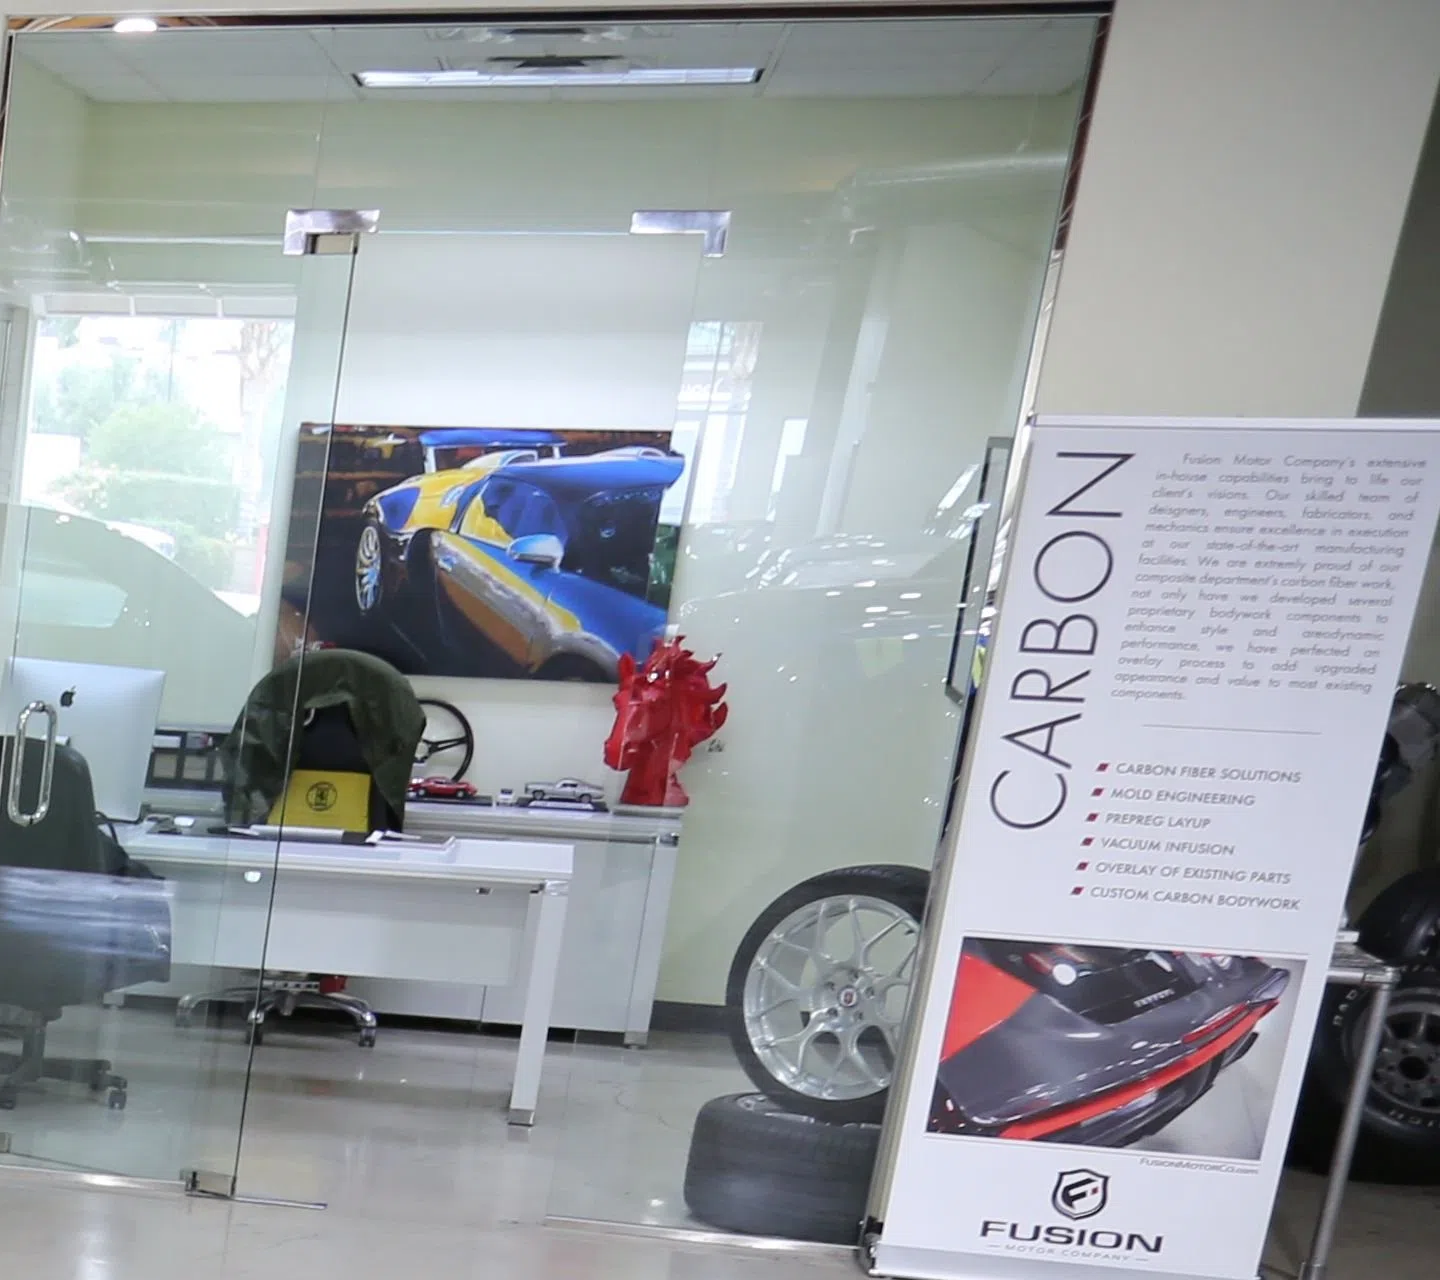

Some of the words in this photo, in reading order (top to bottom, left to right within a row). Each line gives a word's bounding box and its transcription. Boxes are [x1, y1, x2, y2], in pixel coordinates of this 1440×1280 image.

[1182, 454, 1222, 465] Fusion
[1233, 454, 1272, 466] Motor
[1283, 455, 1356, 470] Company's
[1366, 456, 1427, 467] extensive
[1155, 470, 1208, 482] in-house
[1218, 472, 1290, 487] capabilities
[1300, 473, 1333, 488] bring
[1344, 475, 1358, 484] to
[1369, 474, 1389, 485] life
[1400, 477, 1423, 485] our
[1264, 489, 1290, 500] Our
[1304, 490, 1345, 501] skilled
[1358, 492, 1391, 502] team
[1404, 491, 1420, 502] of
[1388, 509, 1415, 520] and
[1144, 522, 1209, 533] mechanics
[1214, 525, 1254, 534] ensure
[1259, 524, 1326, 535] excellence
[1331, 525, 1343, 536] in
[1347, 526, 1409, 537] execution
[1169, 541, 1191, 549] our
[1314, 542, 1405, 558] manufacturing
[1197, 556, 1220, 567] We
[1226, 559, 1247, 568] are
[1313, 560, 1352, 574] proud
[1358, 560, 1373, 571] of
[1379, 563, 1402, 572] our
[1134, 572, 1196, 587] composite
[1281, 576, 1326, 587] carbon
[1328, 576, 1357, 588] fiber
[989, 451, 1136, 830] CARBON
[1115, 763, 1177, 777] CARBON
[1179, 766, 1216, 779] FIBER
[1220, 767, 1301, 783] SOLUTIONS
[1110, 788, 1152, 801] MOLD
[1155, 790, 1255, 806] ENGINEERING
[1104, 812, 1164, 827] PREPREG
[1167, 815, 1211, 829] LAYUP
[1101, 838, 1161, 852] VACUUM
[1164, 841, 1235, 856] INFUSION
[1095, 862, 1157, 877] OVERLAY
[1160, 866, 1180, 878] OF
[1183, 867, 1247, 882] EXISTING
[1249, 870, 1291, 884] PARTS
[1090, 887, 1150, 902] CUSTOM
[1153, 890, 1214, 905] CARBON
[1217, 894, 1300, 910] BODYWORK
[980, 1220, 1163, 1254] FUSION
[1005, 1244, 1055, 1255] MOTOR
[1061, 1249, 1130, 1261] COMPANY
